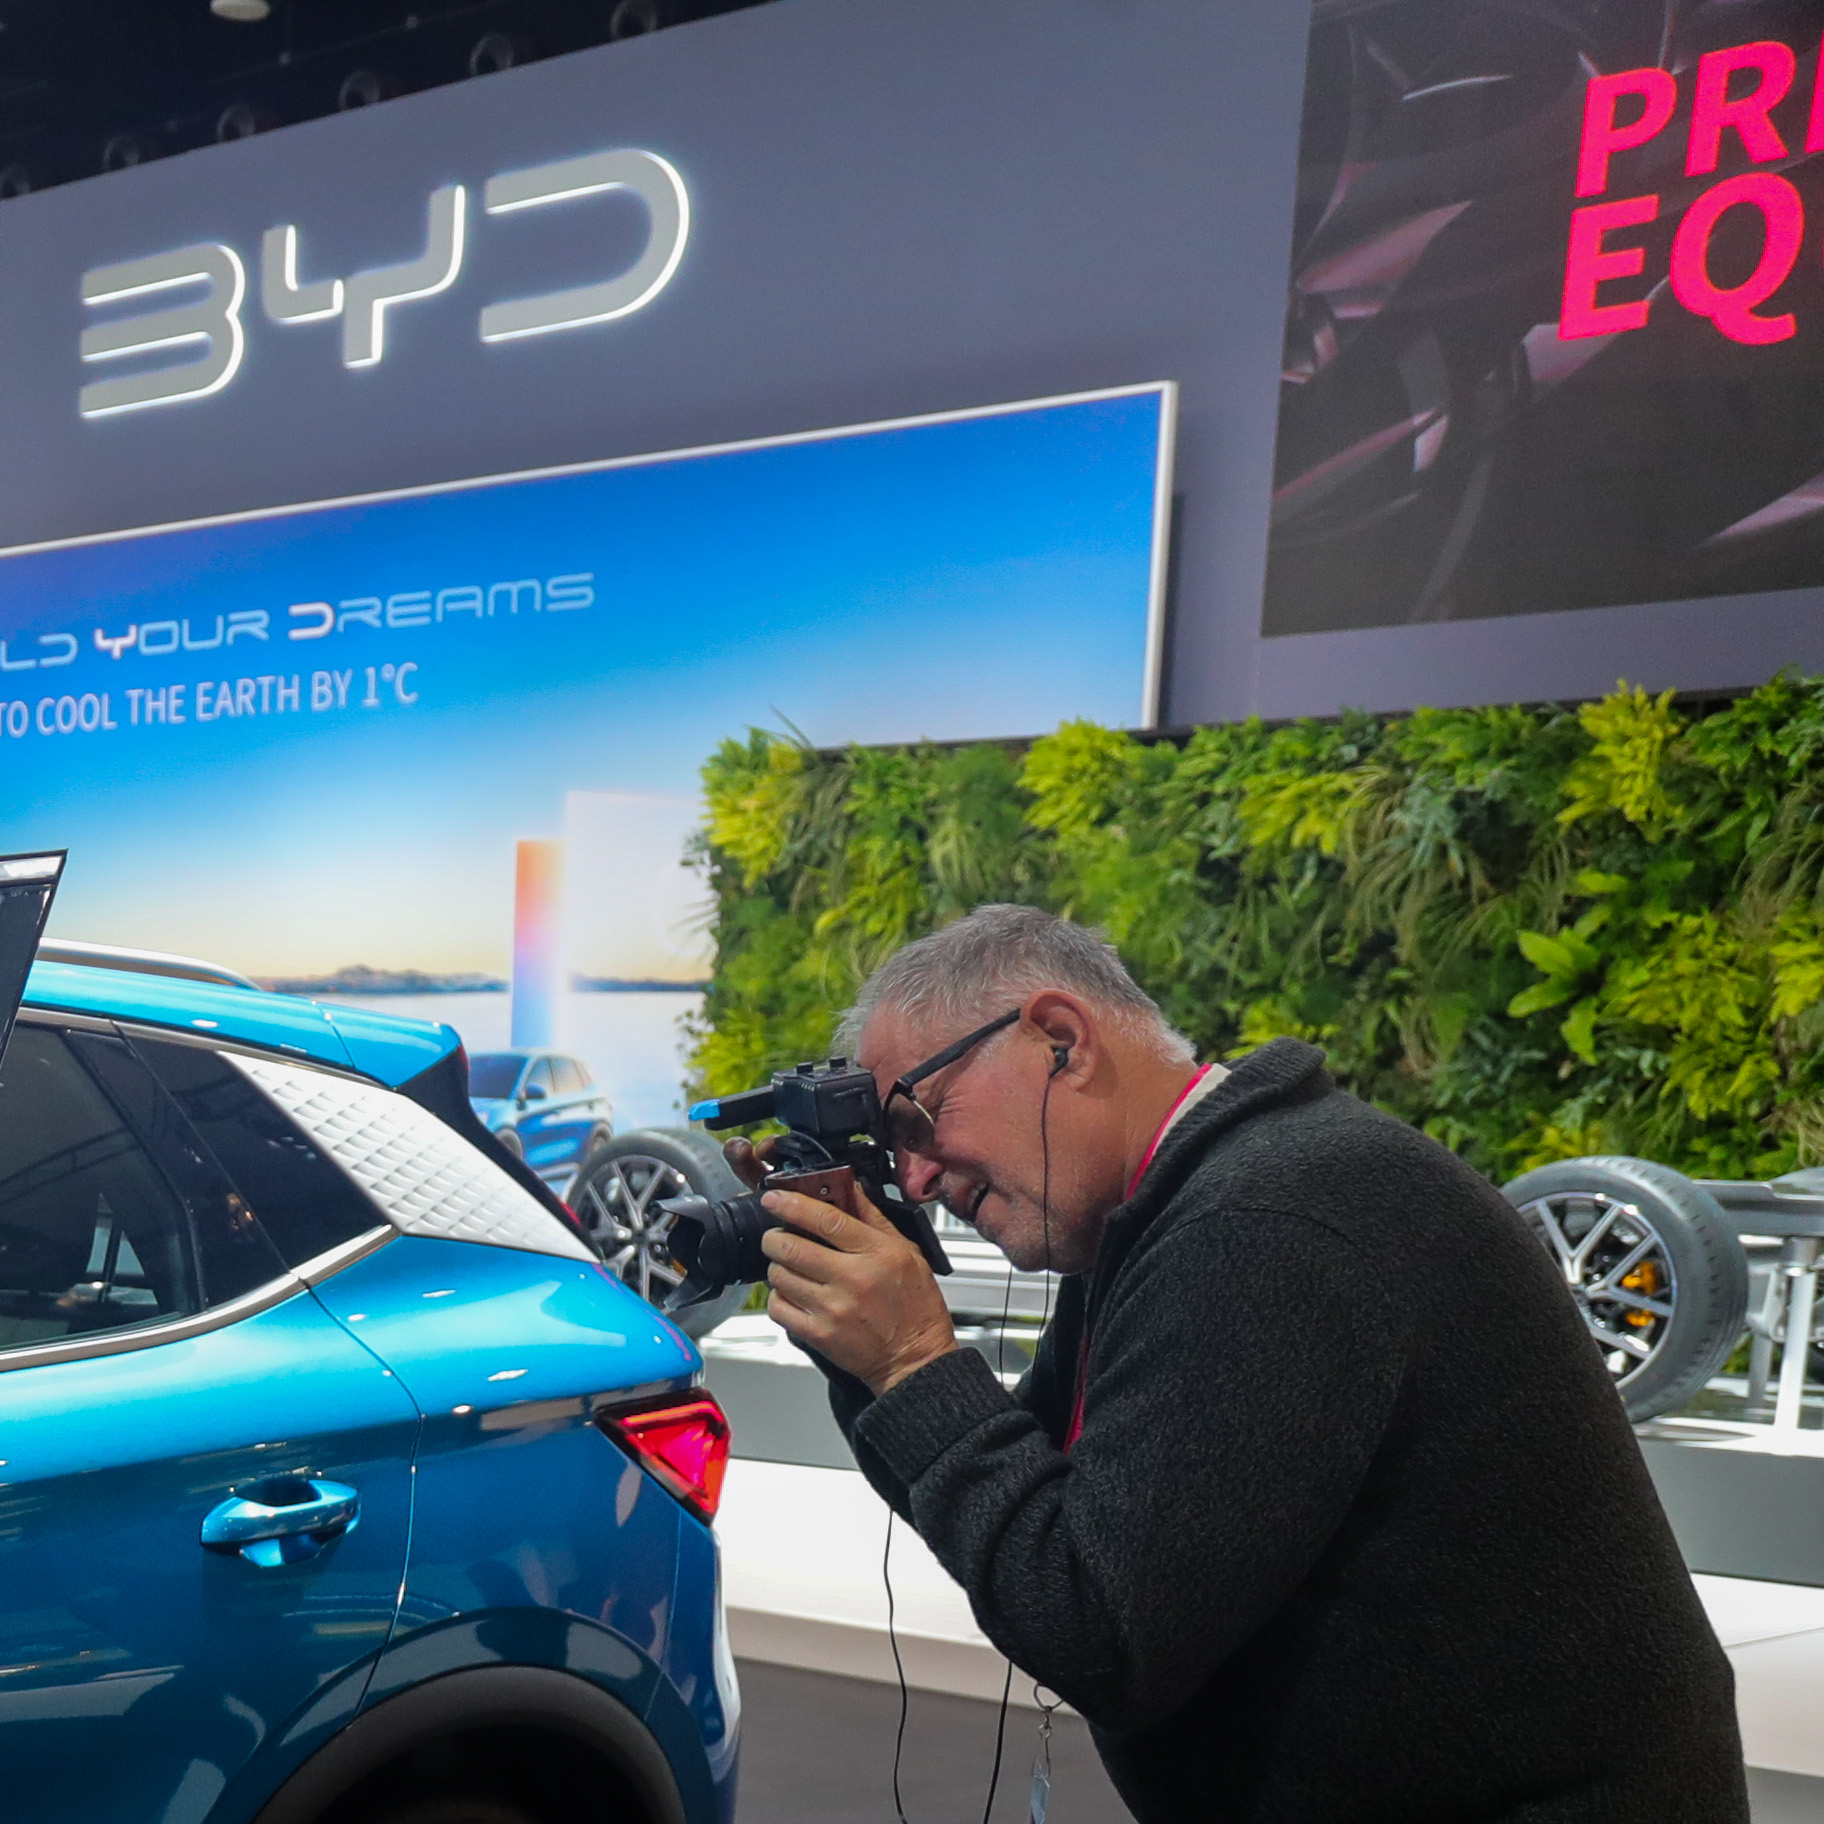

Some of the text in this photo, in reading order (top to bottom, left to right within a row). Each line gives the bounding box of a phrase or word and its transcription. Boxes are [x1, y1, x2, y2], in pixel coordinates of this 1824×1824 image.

[81, 147, 690, 419] BYD
[94, 610, 269, 659] YOUR
[288, 572, 595, 641] DREAMS
[36, 693, 117, 735] COOL
[125, 684, 186, 726] THE
[196, 674, 300, 719] EARTH
[311, 670, 352, 709] BY
